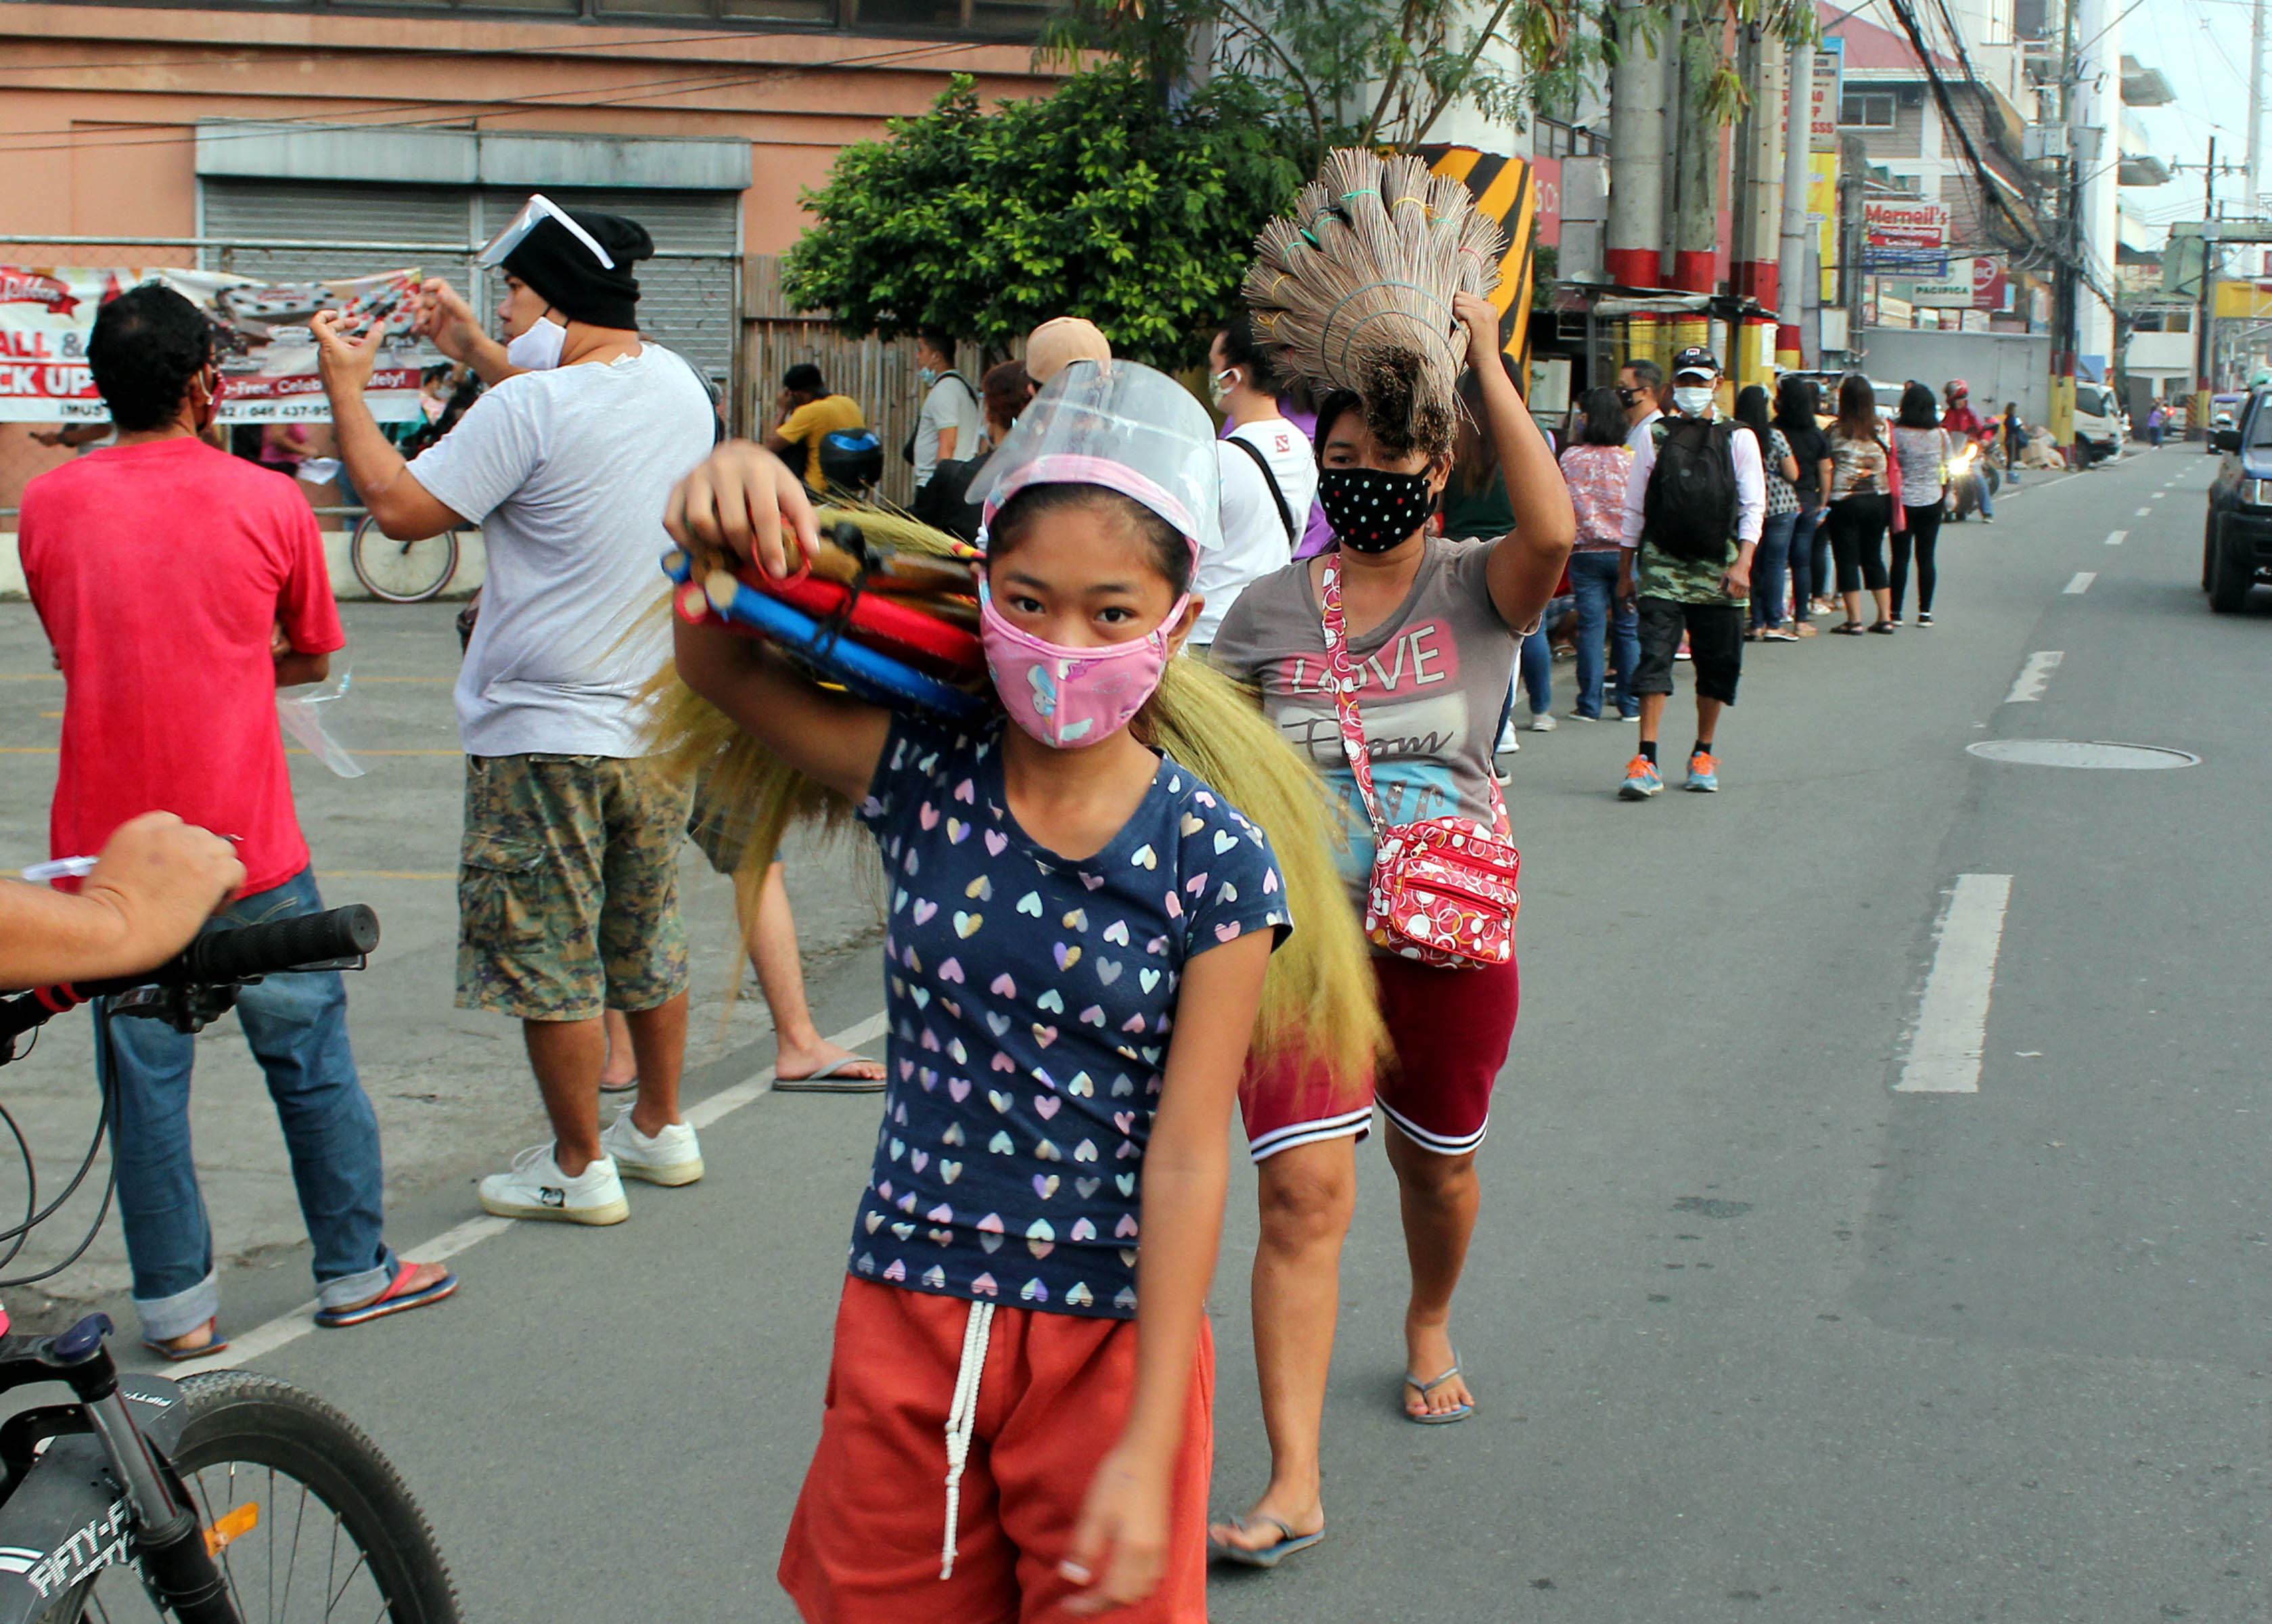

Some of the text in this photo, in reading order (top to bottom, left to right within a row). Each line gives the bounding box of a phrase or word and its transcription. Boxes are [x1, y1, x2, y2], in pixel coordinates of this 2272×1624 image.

[1916, 286, 1969, 294] PACIFICA
[45, 366, 95, 396] UP
[1281, 717, 1455, 763] Fom
